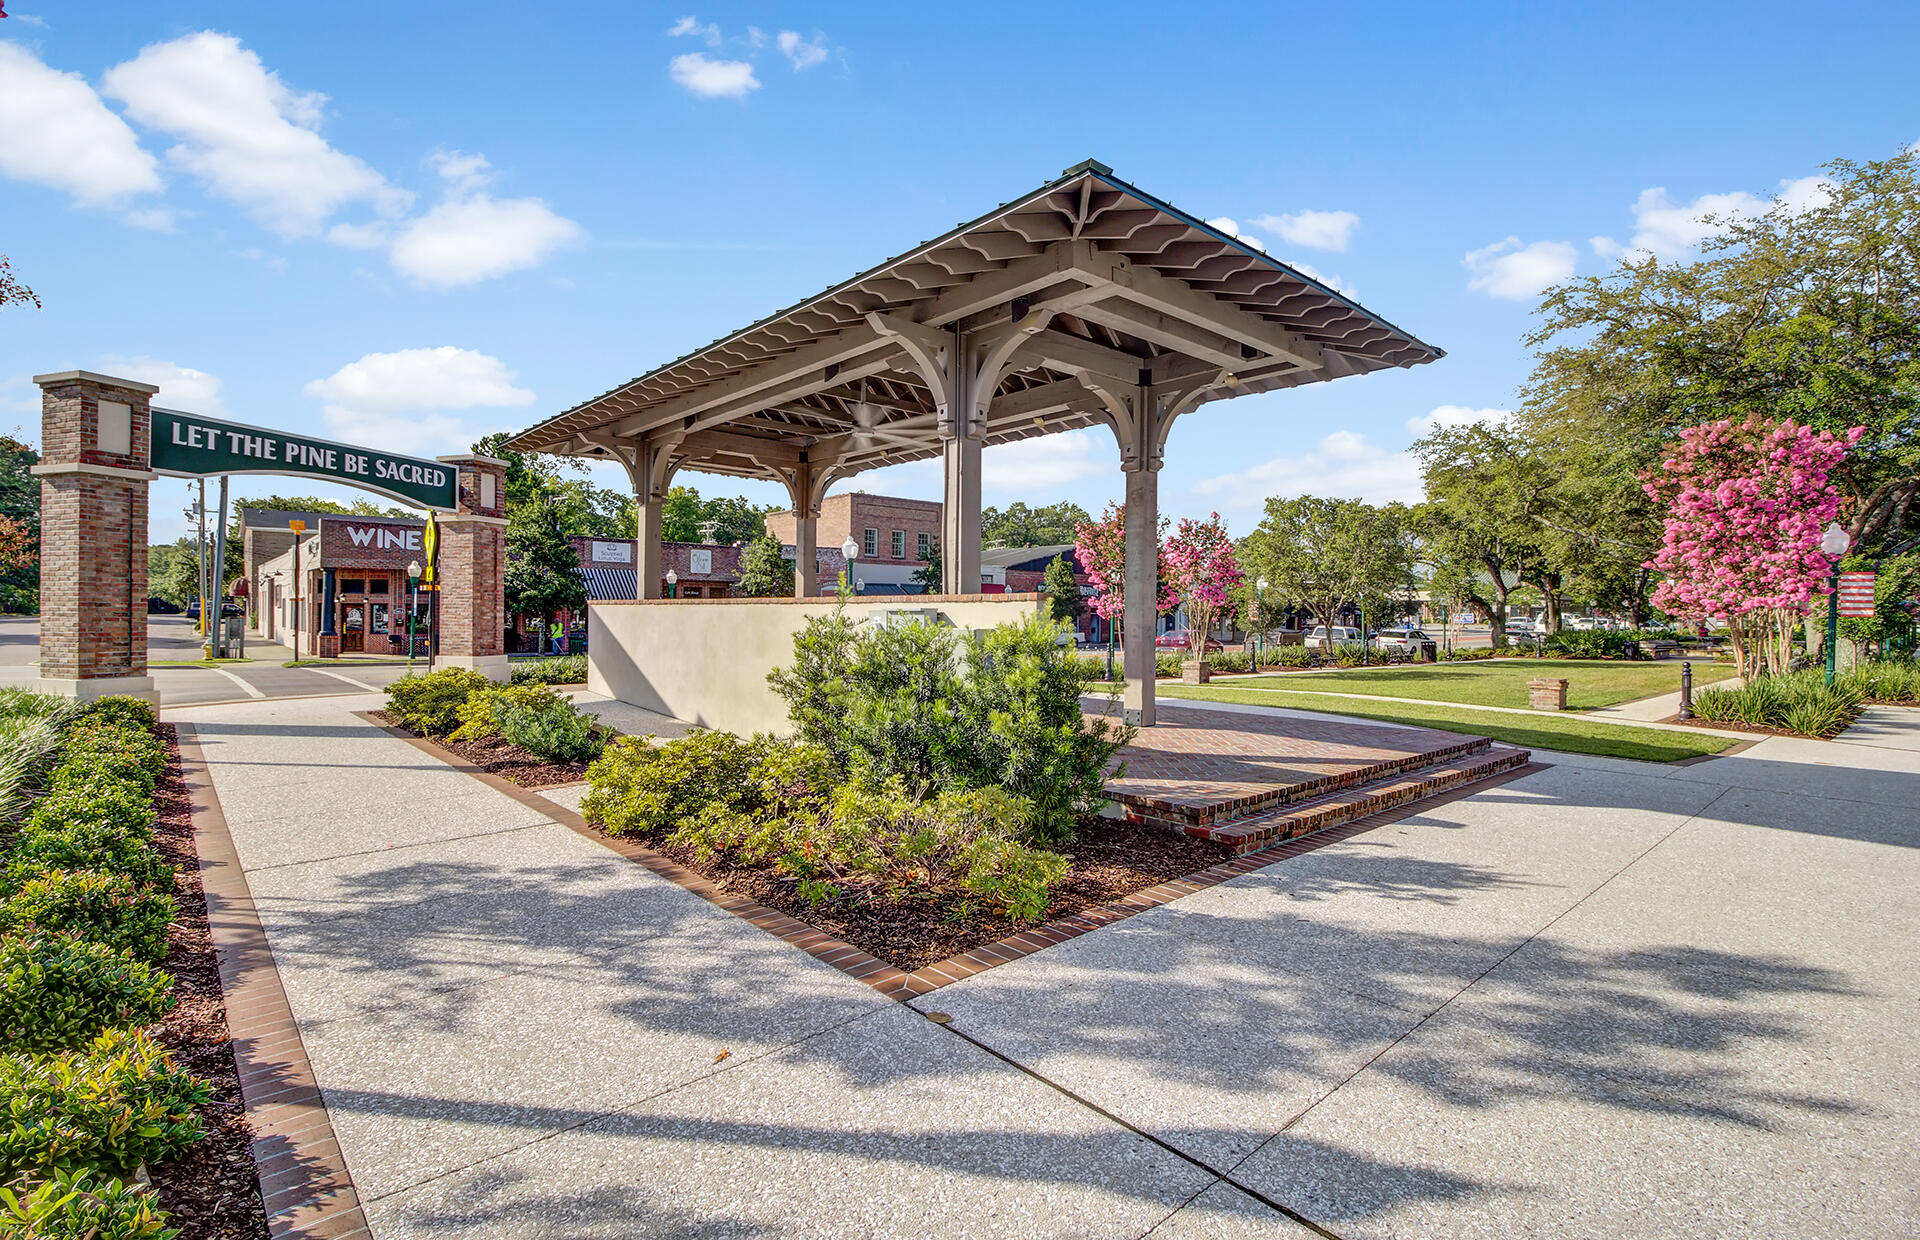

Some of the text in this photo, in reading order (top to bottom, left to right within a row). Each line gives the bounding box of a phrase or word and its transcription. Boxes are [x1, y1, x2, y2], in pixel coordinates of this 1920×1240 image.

[172, 421, 446, 487] LET THE PINE BE SACRED
[347, 526, 422, 551] WINE
